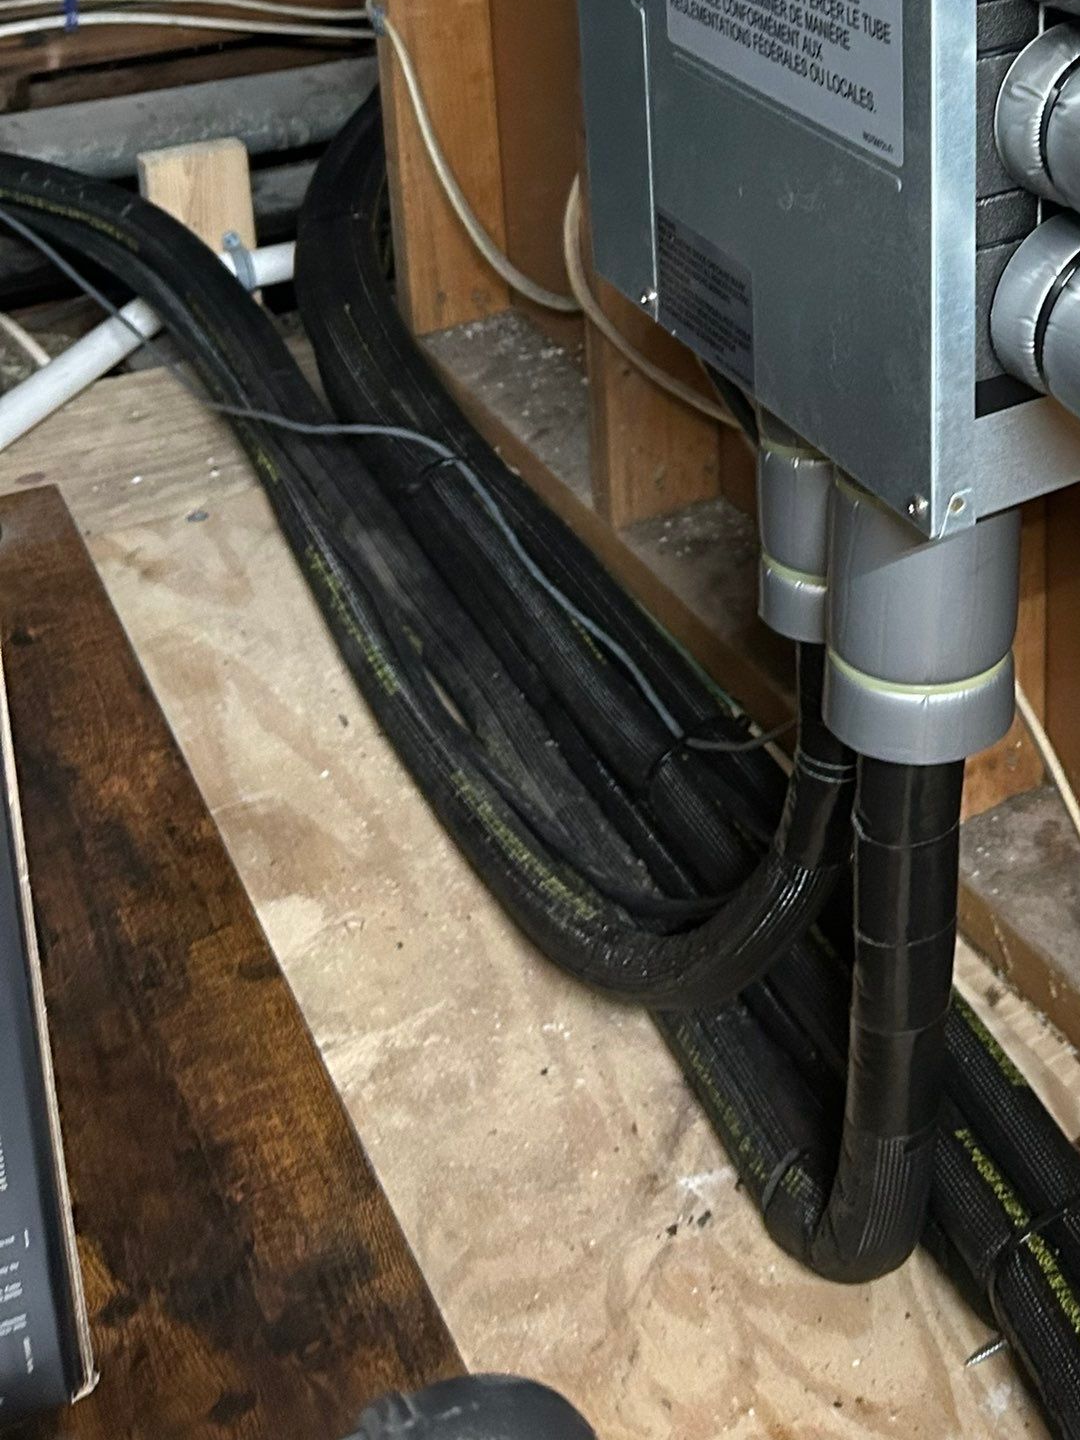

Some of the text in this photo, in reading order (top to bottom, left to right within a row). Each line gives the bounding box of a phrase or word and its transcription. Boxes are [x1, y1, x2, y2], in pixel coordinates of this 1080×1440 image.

[789, 1, 803, 29] DE
[846, 3, 860, 32] LE
[861, 10, 891, 47] TUBE
[801, 32, 823, 64] AUX
[809, 59, 825, 88] OU
[826, 68, 877, 116] LOCALES.
